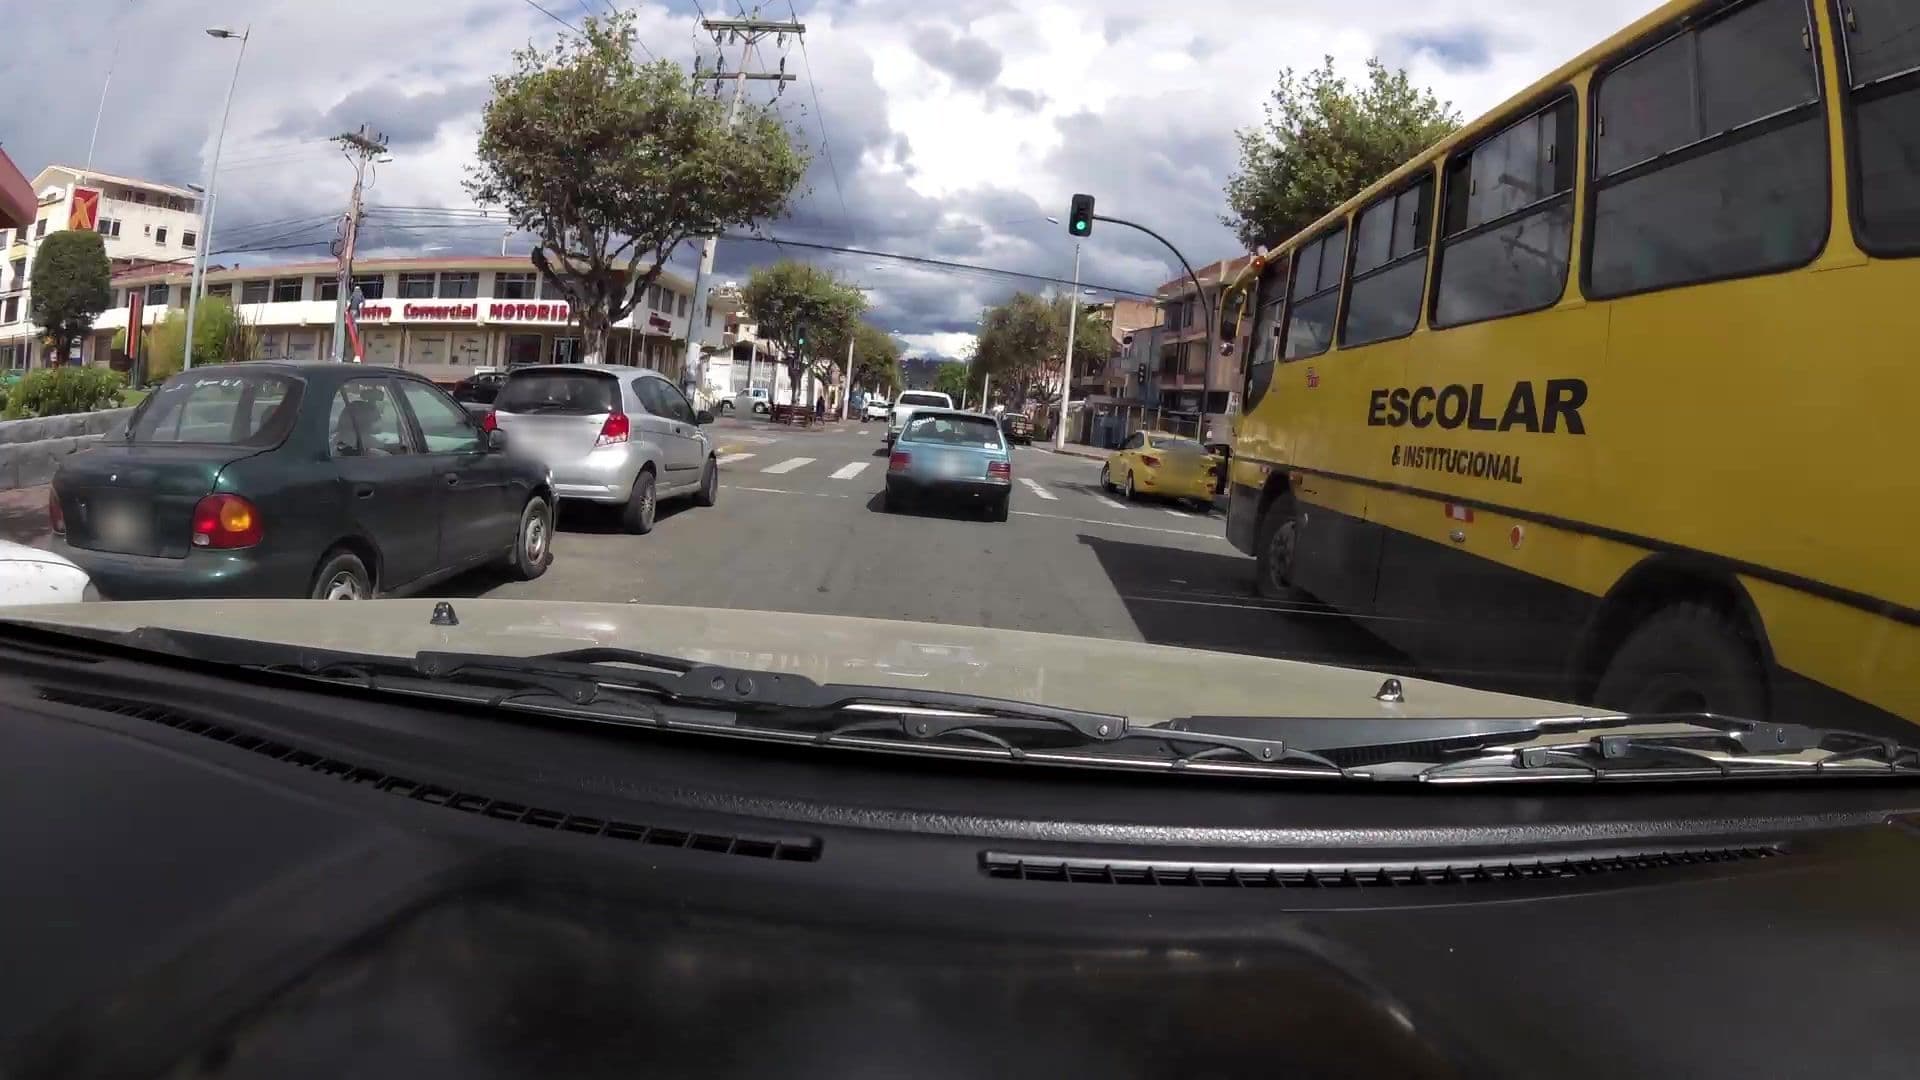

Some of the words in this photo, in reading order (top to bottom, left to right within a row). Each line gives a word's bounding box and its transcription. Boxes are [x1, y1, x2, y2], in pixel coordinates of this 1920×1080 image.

[361, 305, 392, 319] ntro
[404, 303, 478, 320] Comercial
[1368, 378, 1588, 435] ESCOLAR
[1391, 444, 1401, 467] &
[1402, 445, 1524, 484] INSTITUCIONAL
